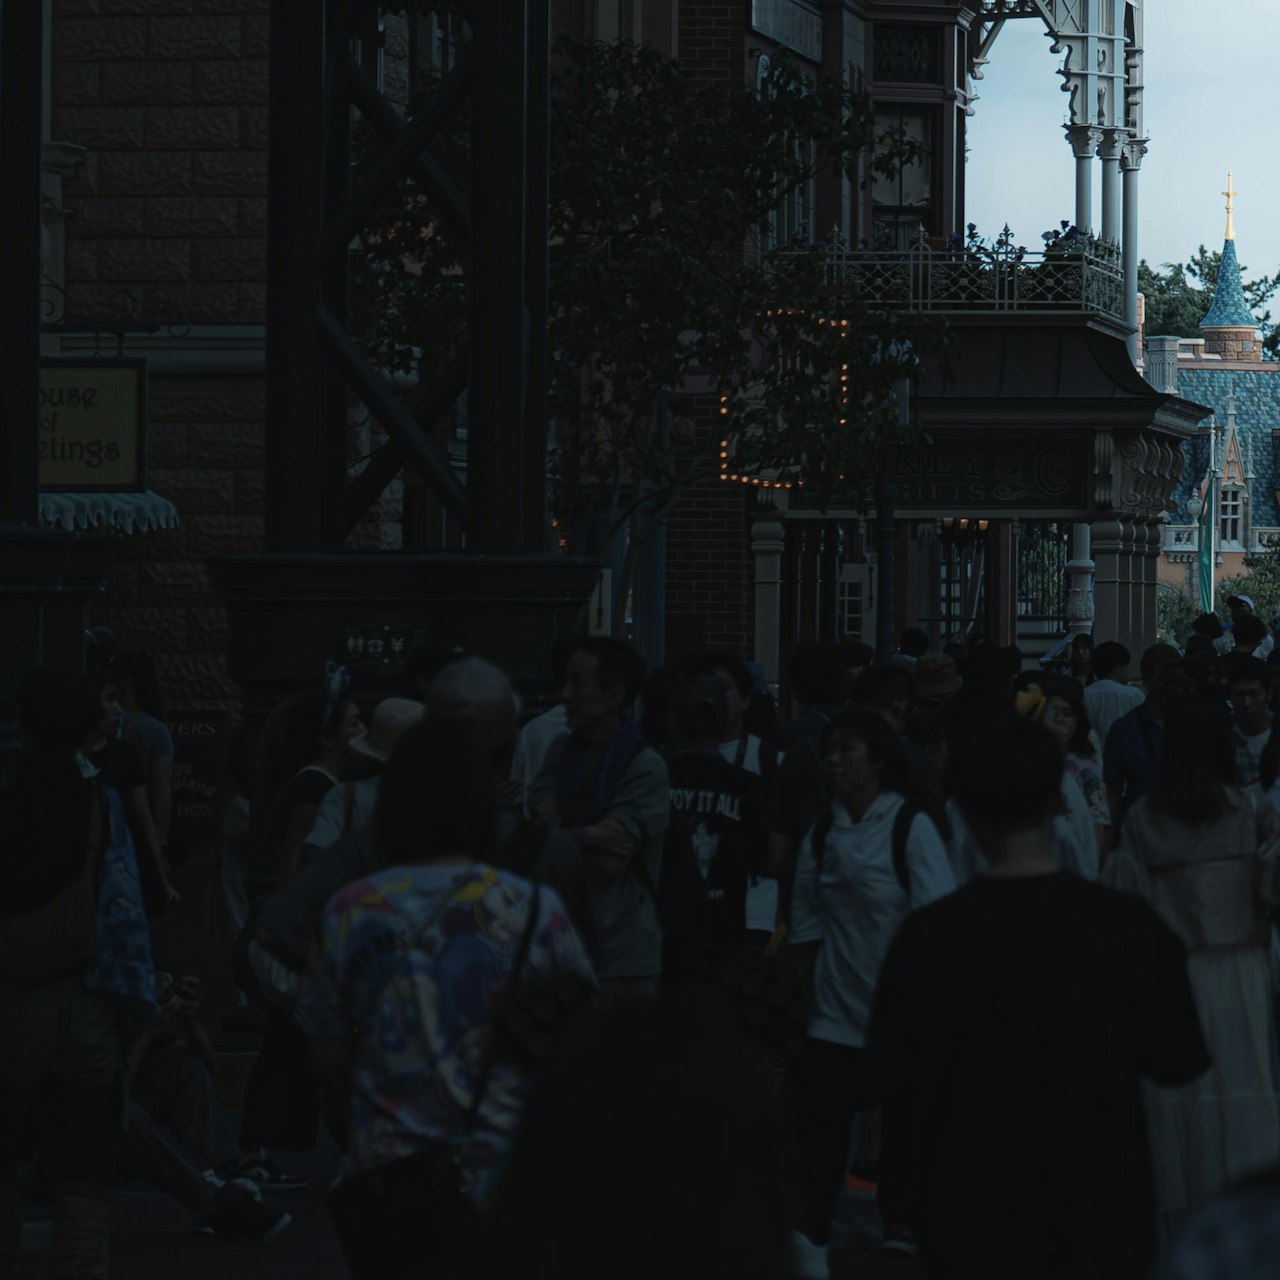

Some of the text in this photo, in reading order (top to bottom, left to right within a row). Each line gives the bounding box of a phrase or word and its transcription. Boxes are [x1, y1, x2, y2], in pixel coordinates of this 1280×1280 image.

[39, 412, 58, 433] of
[177, 803, 215, 817] BOX
[696, 790, 715, 813] IT
[715, 793, 742, 822] ALL
